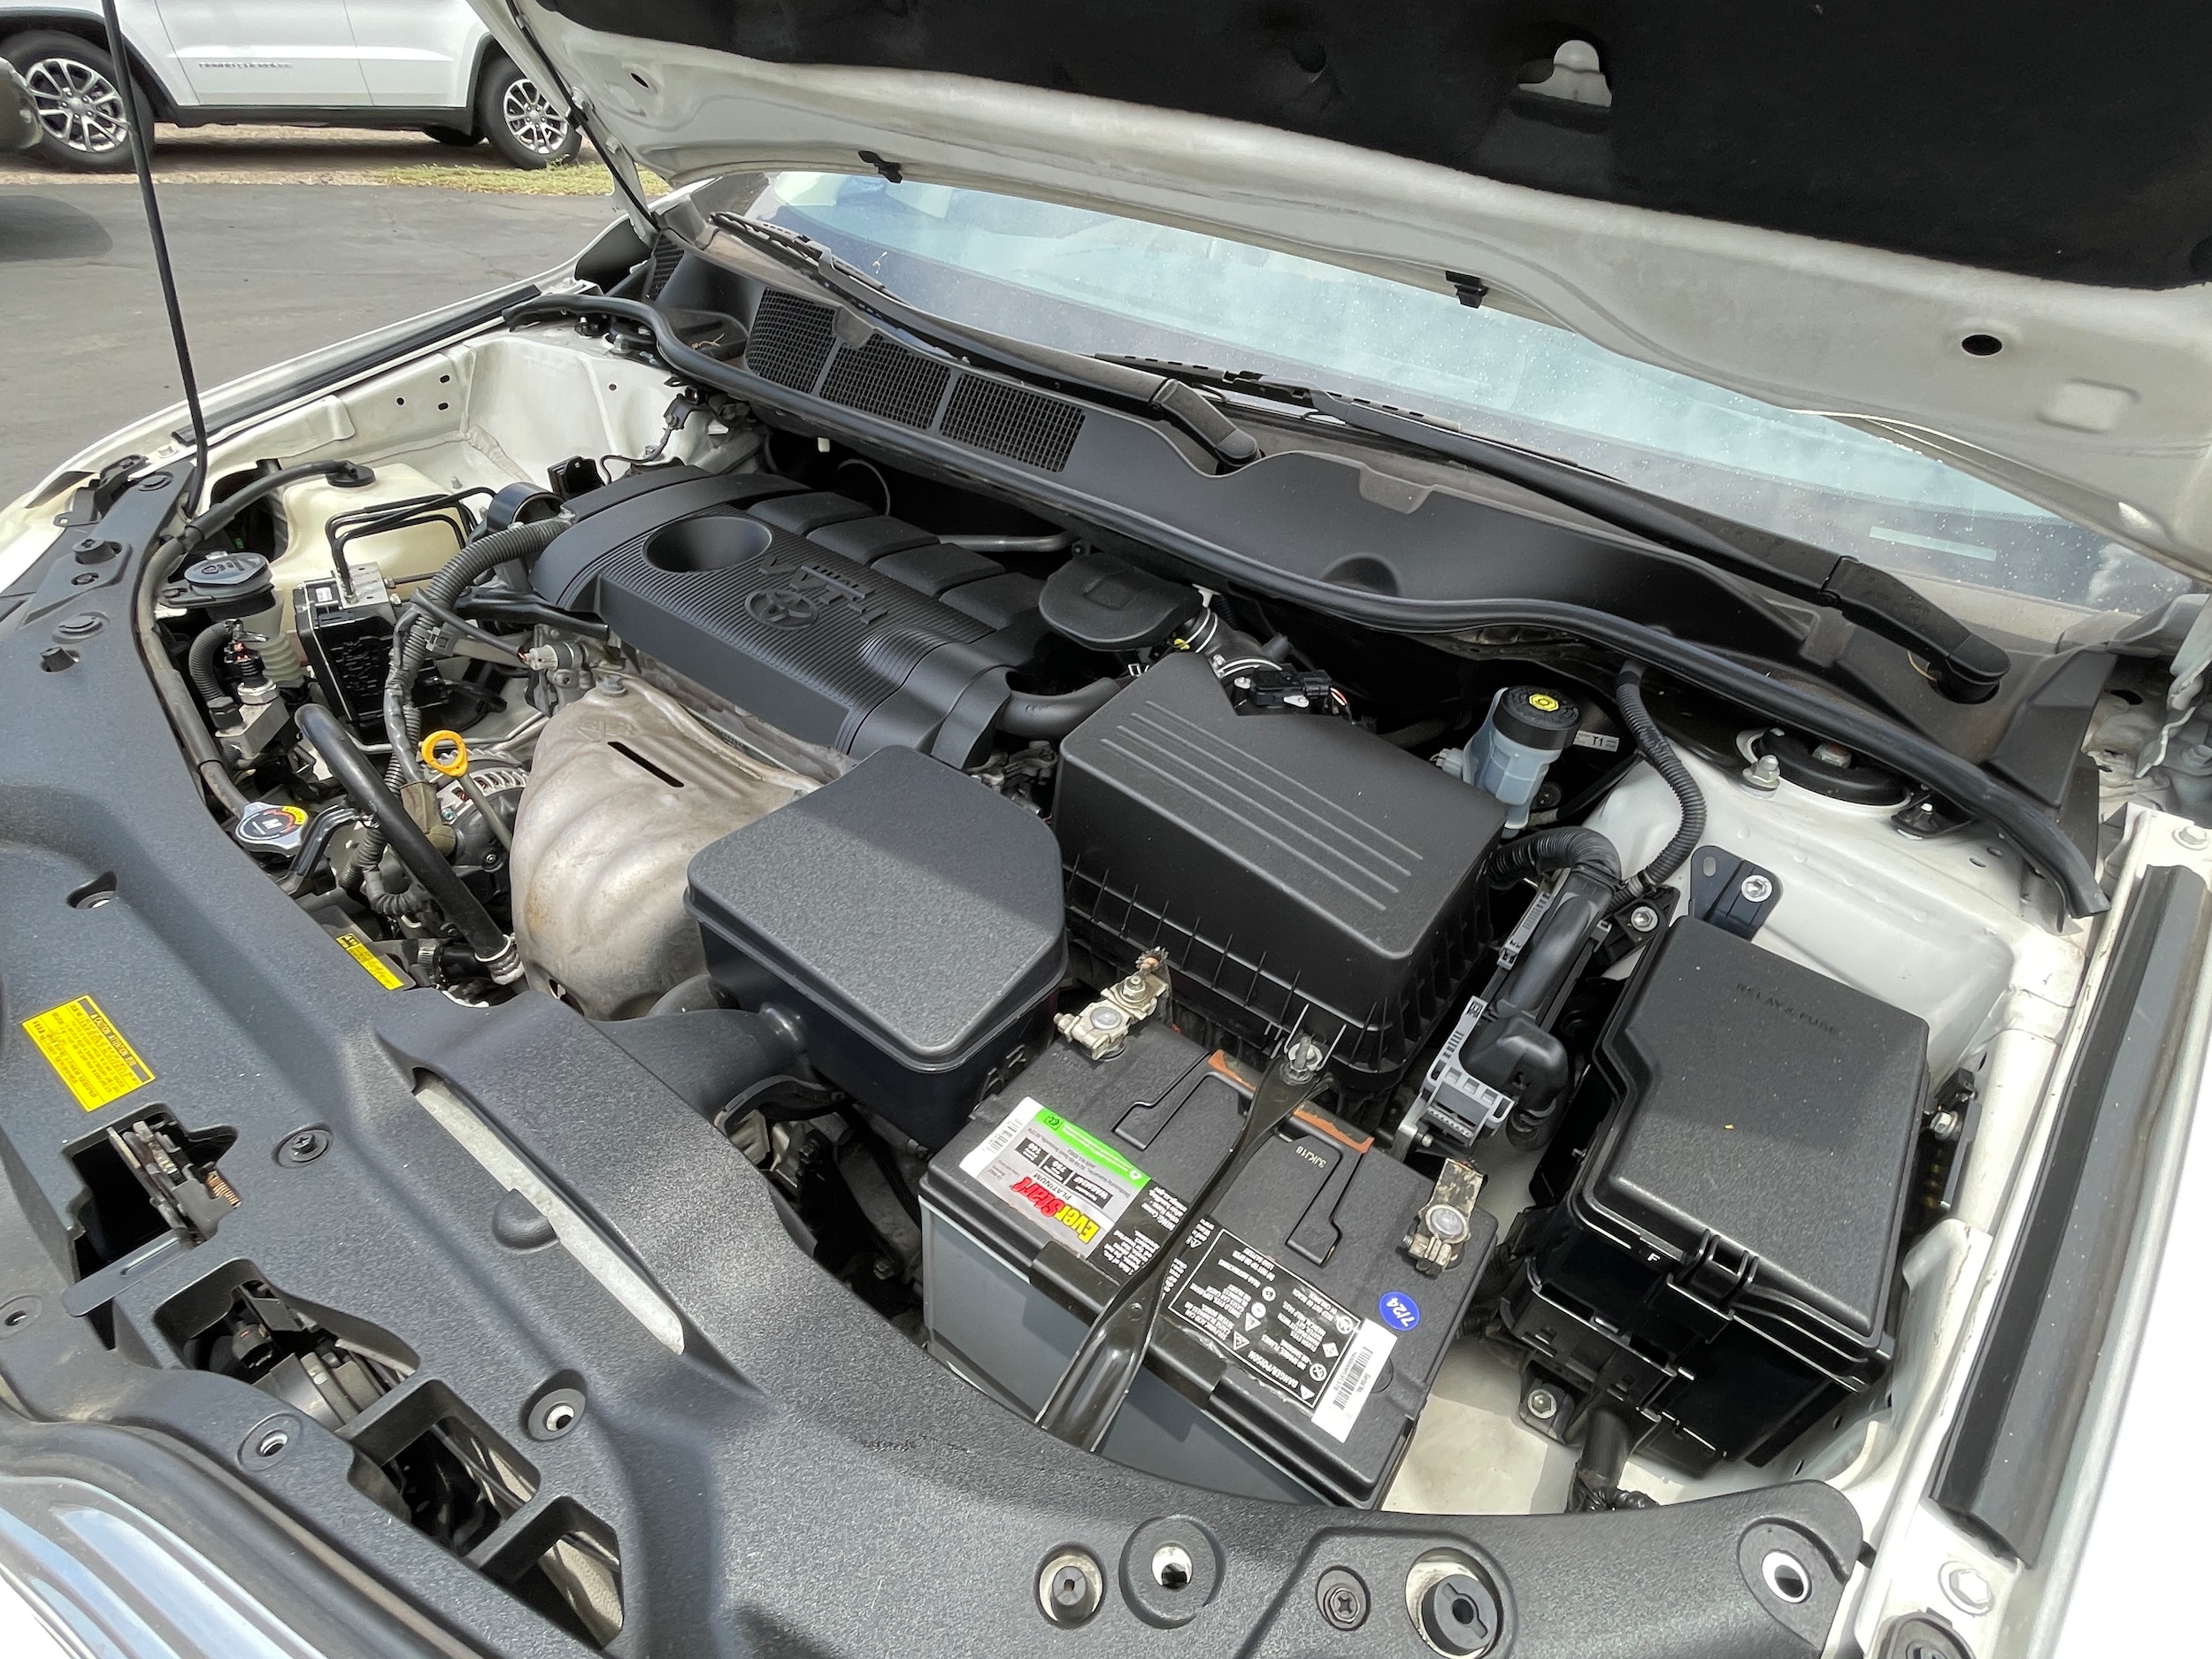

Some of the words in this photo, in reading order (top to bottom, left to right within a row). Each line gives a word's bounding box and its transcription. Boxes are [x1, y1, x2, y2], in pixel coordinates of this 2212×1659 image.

[1592, 735, 1602, 746] T1
[1033, 1171, 1071, 1201] PLATINUM
[1010, 1176, 1101, 1245] EverStart
[1141, 1202, 1158, 1218] Cancer
[1151, 1201, 1166, 1215] Harm
[1102, 1242, 1115, 1253] not
[1111, 1240, 1129, 1256] above
[1231, 1249, 1246, 1262] OPEN
[1242, 1247, 1263, 1263] BATTERY
[1127, 1252, 1141, 1264] heat
[1647, 1252, 1660, 1261] F
[1117, 1260, 1131, 1273] Risk
[1217, 1257, 1248, 1280] INSTRUCTIONS
[1245, 1273, 1261, 1288] READ
[1188, 1282, 1214, 1301] EXPLOSIVE
[1205, 1285, 1222, 1297] CAUSE
[1222, 1287, 1248, 1307] BLINDNESS
[1226, 1283, 1245, 1297] INJURY
[1291, 1287, 1308, 1303] REACH
[1223, 1302, 1241, 1318] SHIELD
[1228, 1299, 1245, 1313] GASES
[1385, 1296, 1415, 1327] 7/24
[1191, 1305, 1217, 1325] BLINDNESS
[1216, 1313, 1234, 1329] SEVERE
[1276, 1311, 1292, 1326] WITH
[1293, 1310, 1307, 1322] HELP
[1320, 1309, 1334, 1321] KEEP
[1203, 1321, 1228, 1340] SULFURIC
[1215, 1320, 1232, 1334] CAUSE
[1288, 1322, 1320, 1347] IMMEDIATELY
[1304, 1317, 1326, 1337] MEDICAL
[1260, 1333, 1281, 1351] FLAMES
[1289, 1330, 1302, 1342] EYES
[1279, 1338, 1303, 1358] SMOKING
[1300, 1337, 1317, 1352] FLUSH
[1247, 1349, 1299, 1388] DANGER/POISON
[1296, 1359, 1307, 1371] NO
[1358, 1371, 1371, 1388] Serial
